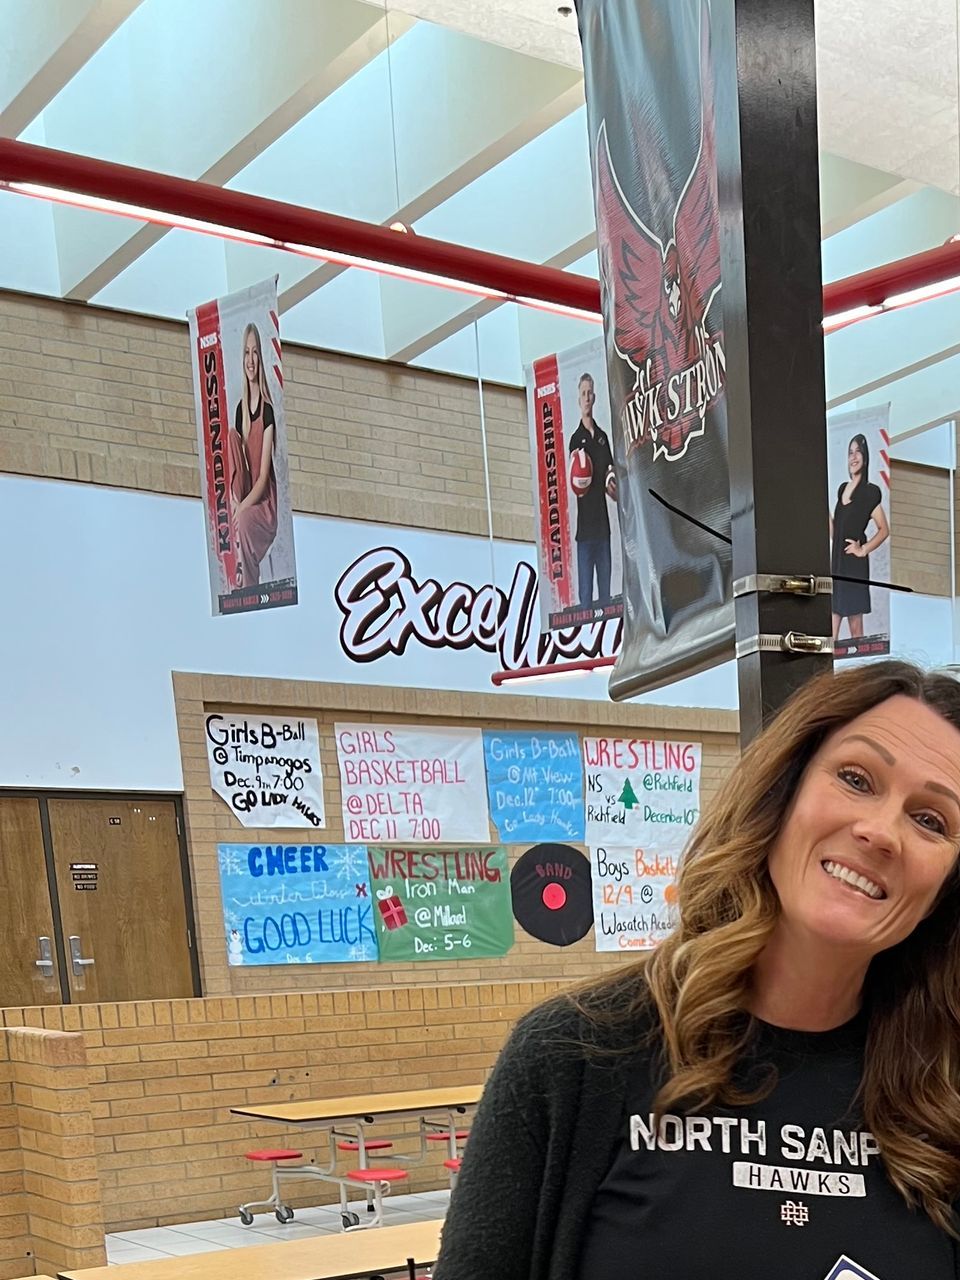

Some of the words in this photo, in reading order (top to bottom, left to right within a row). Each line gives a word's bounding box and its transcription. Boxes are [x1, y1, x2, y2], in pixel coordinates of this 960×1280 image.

[667, 342, 726, 420] STRON
[204, 351, 232, 554] KINDNESS
[542, 401, 564, 580] LEADERSHIP
[206, 714, 258, 746] Girls
[339, 730, 396, 754] GIRLS
[231, 745, 312, 776] Timpanogos
[490, 738, 526, 761] Girls
[585, 738, 695, 772] WRESTLING
[344, 758, 465, 785] BASKETBALL
[588, 774, 602, 792] NS
[232, 790, 258, 812] GO
[588, 805, 626, 824] Richfield
[386, 819, 397, 839] 11
[408, 818, 440, 840] 7:00
[248, 845, 329, 877] CHEER
[368, 849, 501, 883] WRESTLING
[535, 862, 572, 880] BAND
[597, 848, 630, 881] Boys
[405, 878, 436, 899] Iron
[448, 878, 475, 895] Man
[602, 884, 633, 904] 12/9
[640, 884, 653, 903] @
[244, 912, 312, 954] GOOD
[318, 904, 376, 945] LUCK
[600, 912, 648, 935] Wasatch
[629, 1112, 767, 1156] NORTH
[780, 1124, 882, 1166] SANP
[750, 1164, 850, 1195] HAWKS
